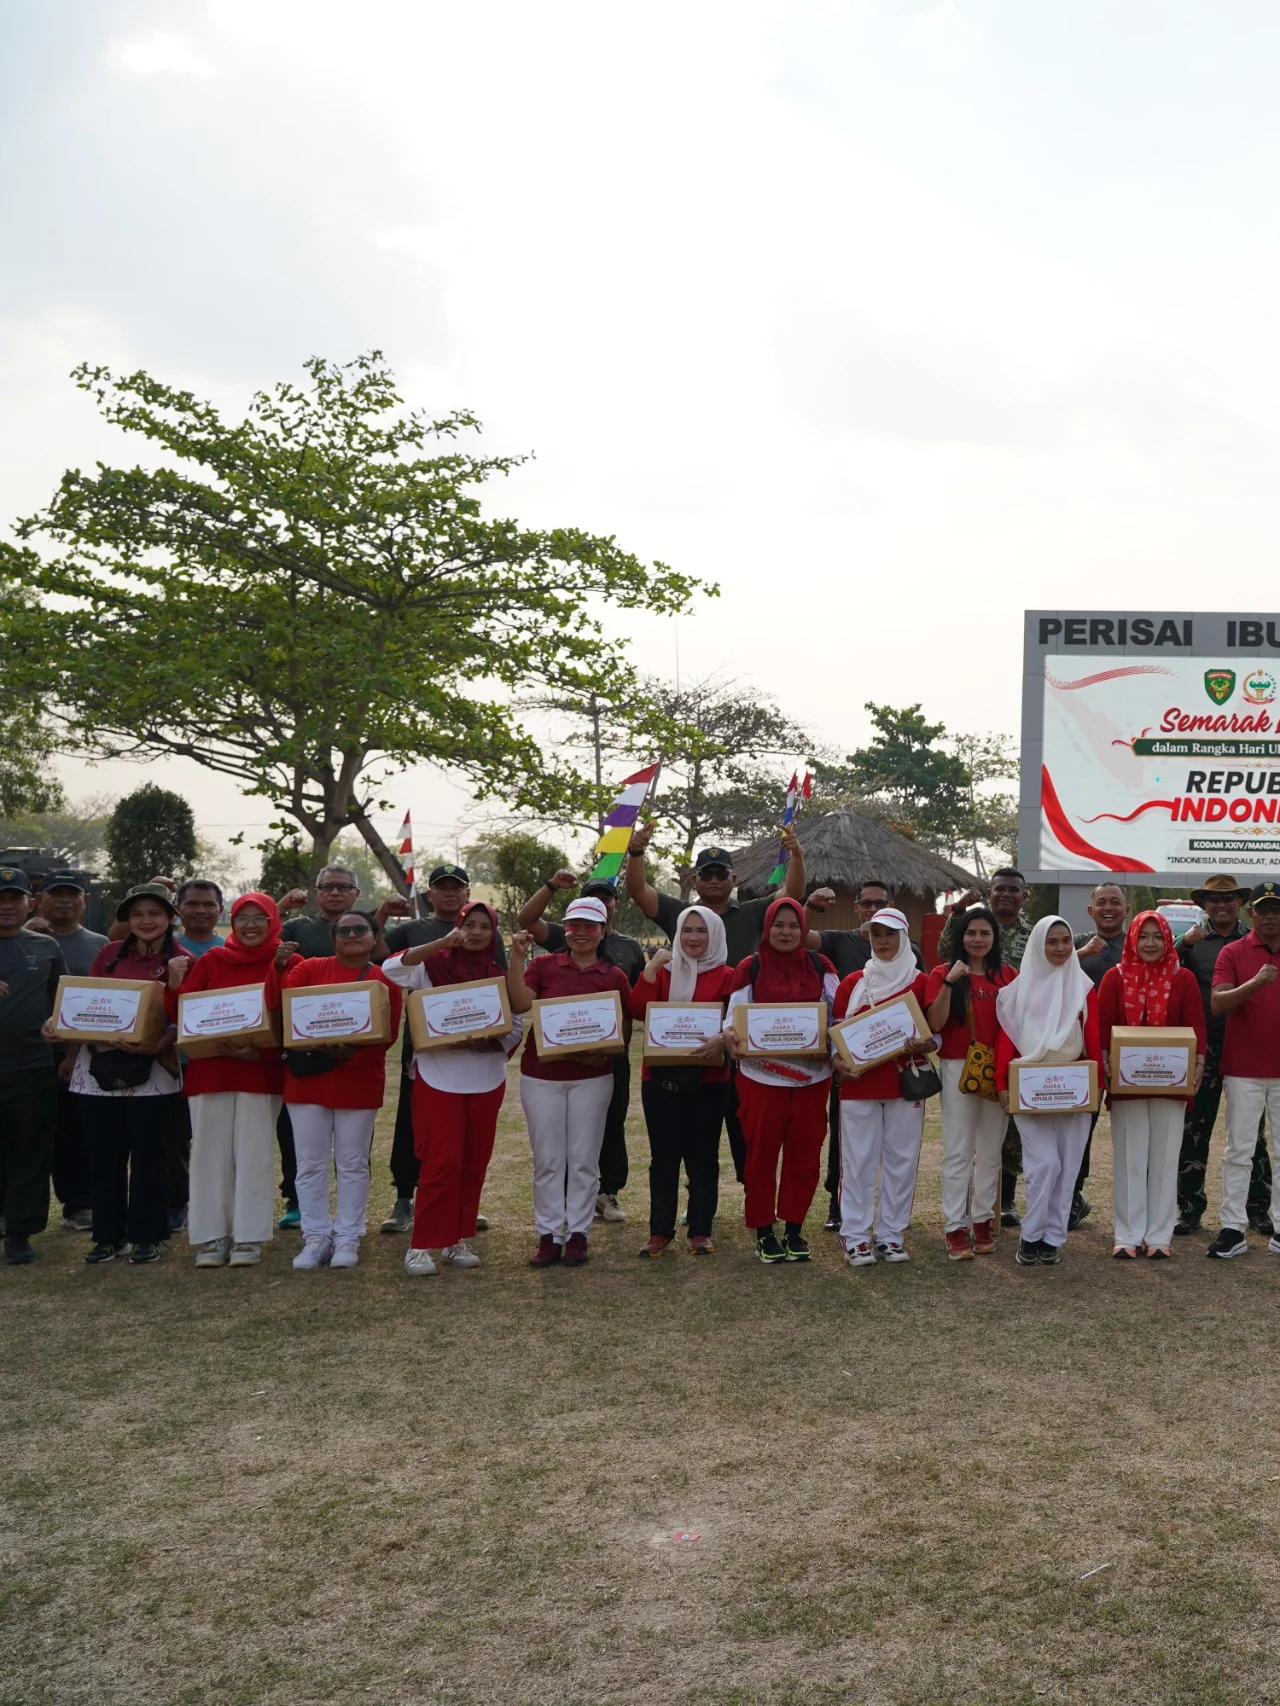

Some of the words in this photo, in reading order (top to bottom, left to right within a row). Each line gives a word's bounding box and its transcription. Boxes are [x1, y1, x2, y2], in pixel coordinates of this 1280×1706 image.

[1038, 618, 1193, 646] PERISAI
[1160, 707, 1273, 734] Semarak
[1152, 742, 1188, 753] dalam
[1192, 743, 1236, 756] Rangka
[1239, 743, 1266, 755] Hari
[1193, 841, 1224, 849] KODAM
[1218, 858, 1268, 866] BERDAULAT,
